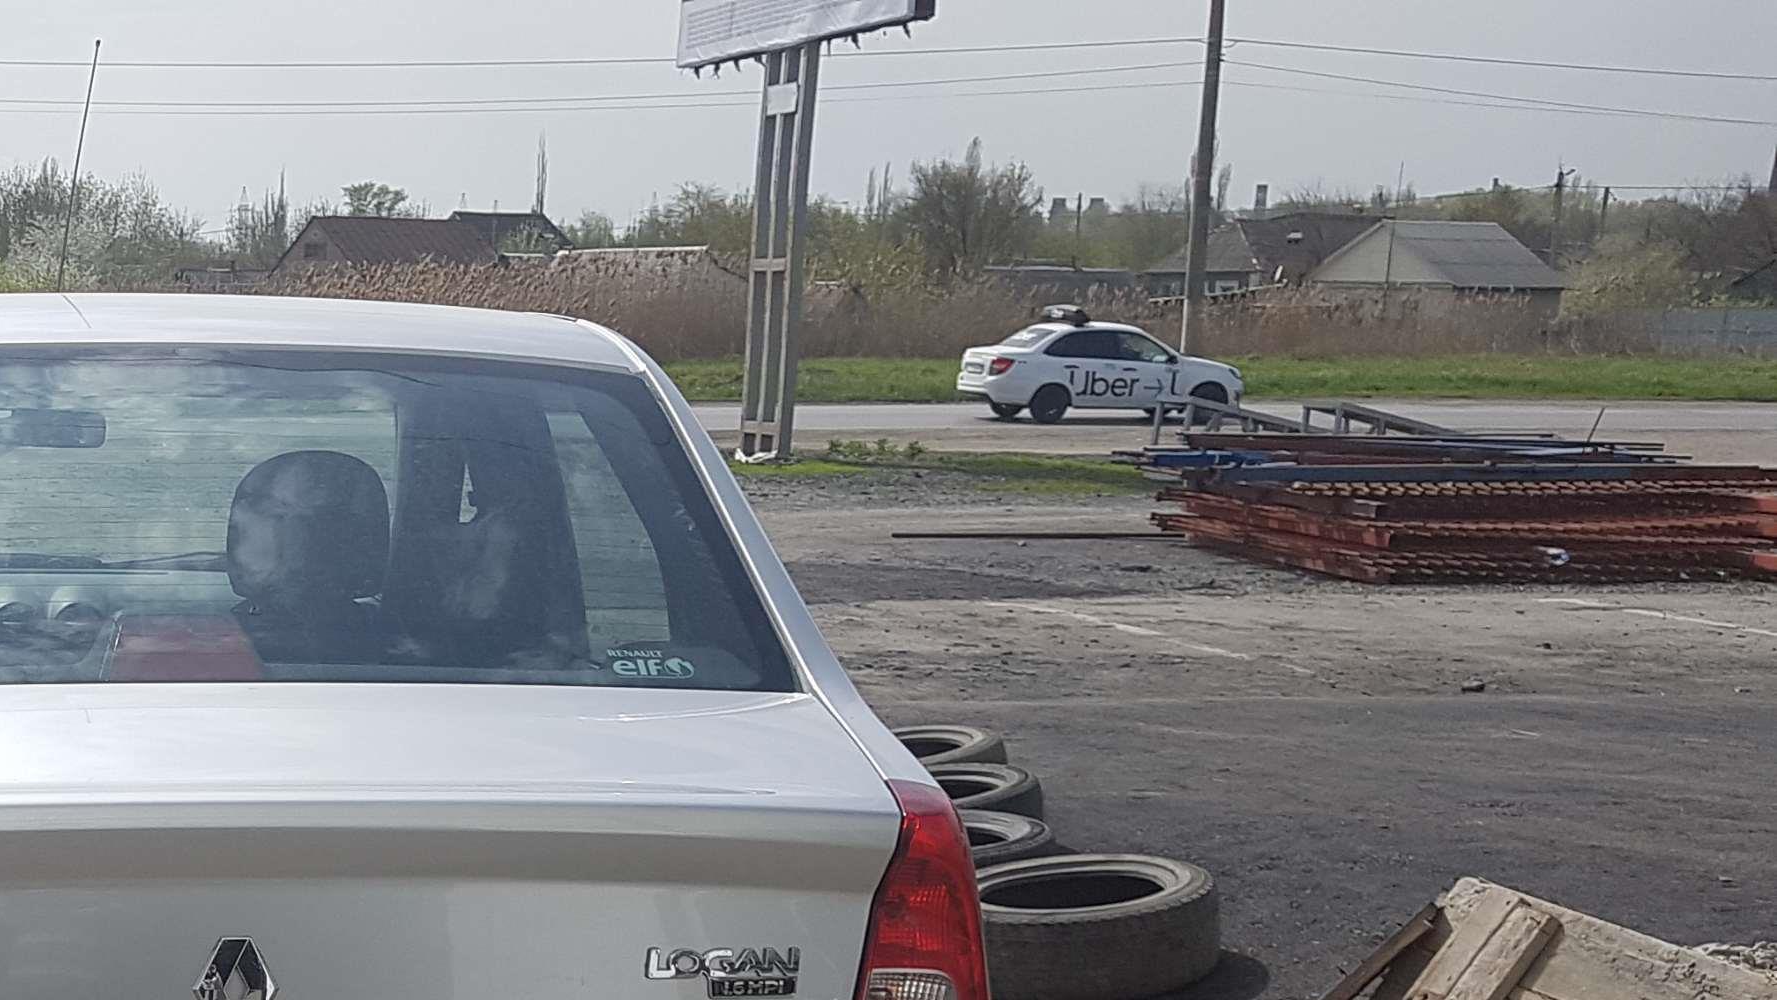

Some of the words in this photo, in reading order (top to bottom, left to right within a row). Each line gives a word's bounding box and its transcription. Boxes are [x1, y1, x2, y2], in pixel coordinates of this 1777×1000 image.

[1070, 369, 1139, 397] Uber
[606, 649, 662, 658] RENAULT
[612, 658, 663, 676] elf
[644, 946, 801, 979] LOGAN
